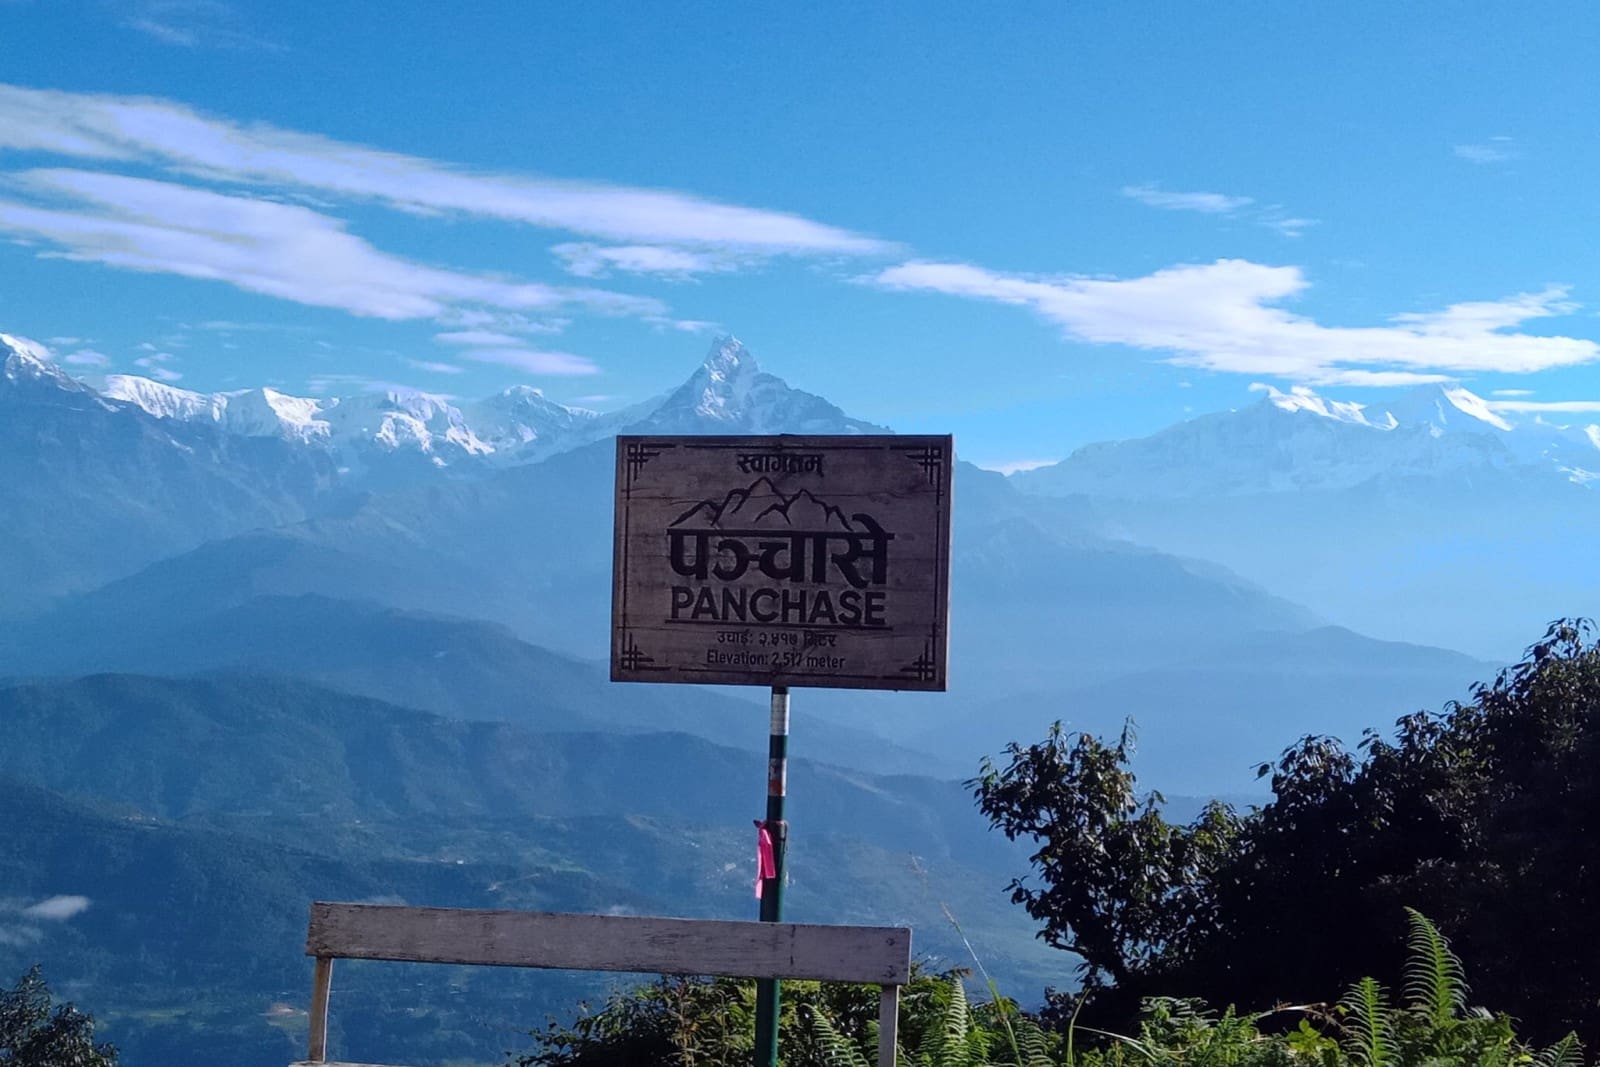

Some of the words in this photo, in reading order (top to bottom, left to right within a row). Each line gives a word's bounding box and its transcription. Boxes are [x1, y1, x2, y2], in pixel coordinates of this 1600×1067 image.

[736, 454, 824, 477] स्वागतम्
[671, 586, 886, 624] PANCHASE
[707, 649, 768, 665] Elevation:
[806, 656, 846, 668] meter
